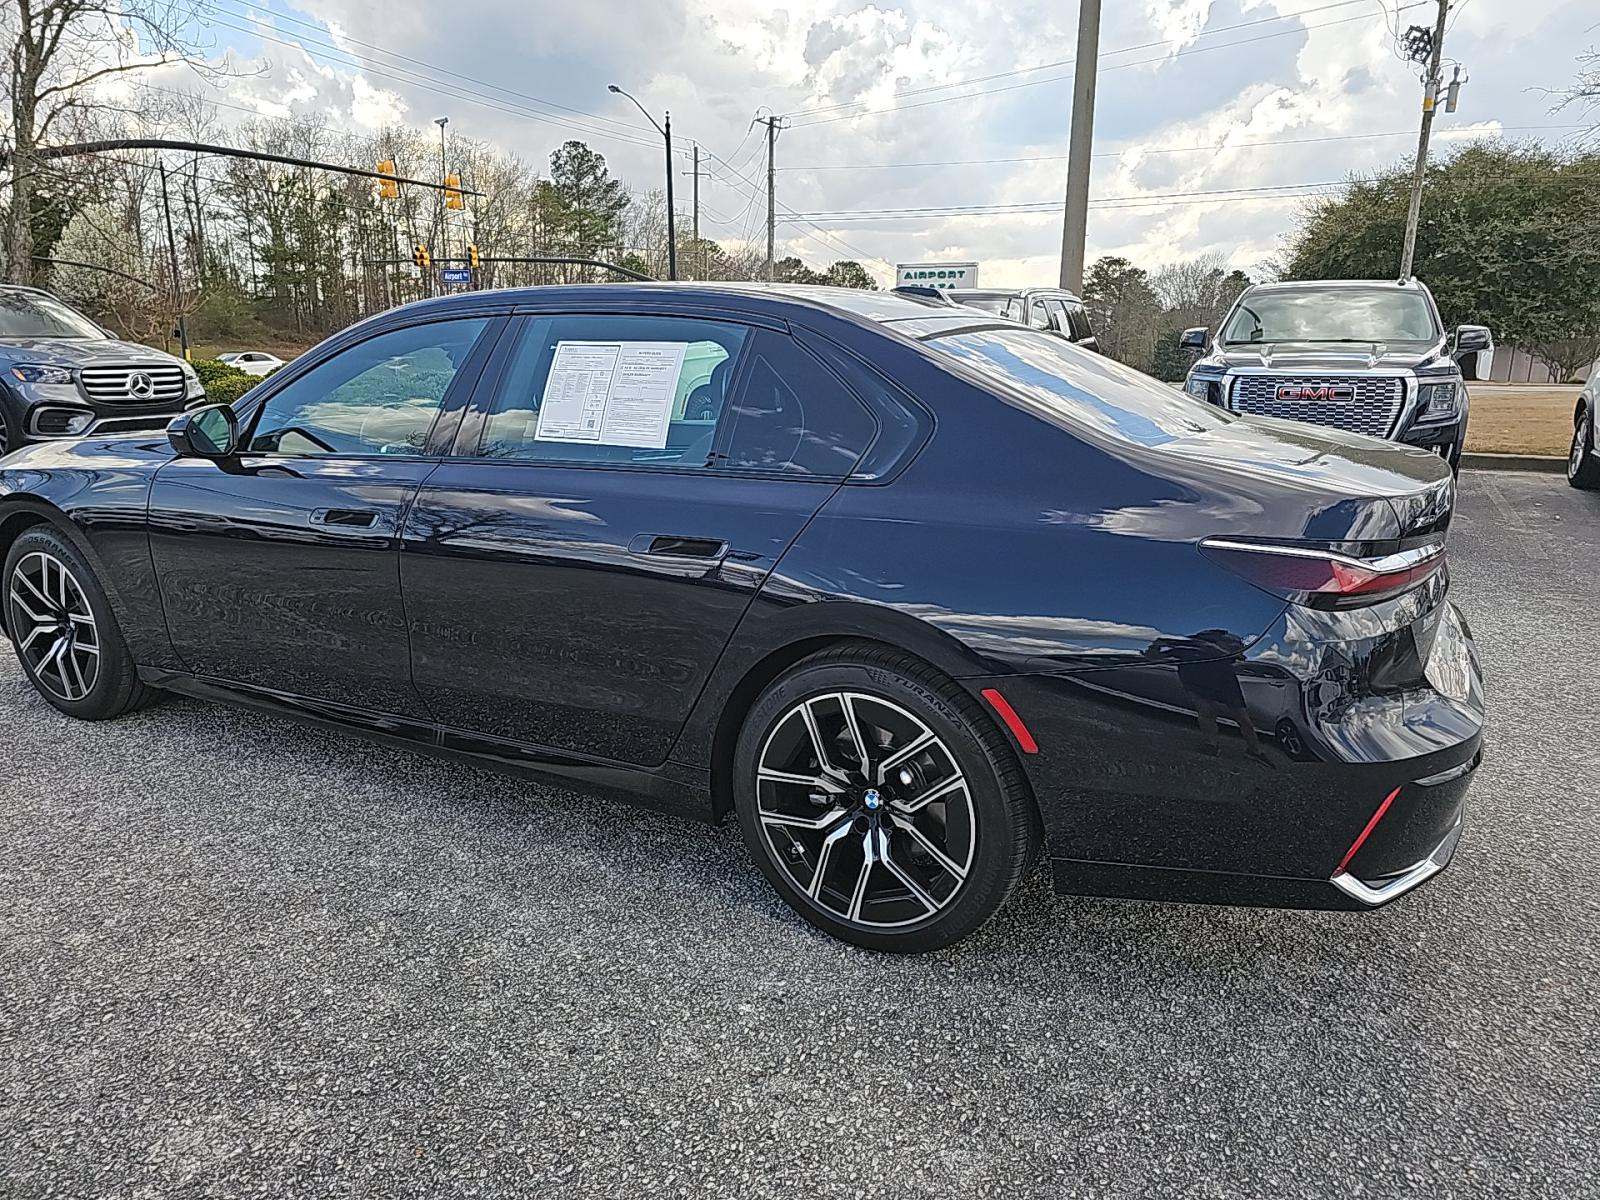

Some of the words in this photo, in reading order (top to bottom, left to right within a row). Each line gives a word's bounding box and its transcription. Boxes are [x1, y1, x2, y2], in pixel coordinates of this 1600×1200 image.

[444, 272, 463, 281] Airport
[904, 270, 966, 280] AIRPORT
[1278, 386, 1353, 400] GMC
[893, 675, 963, 729] TURANZA
